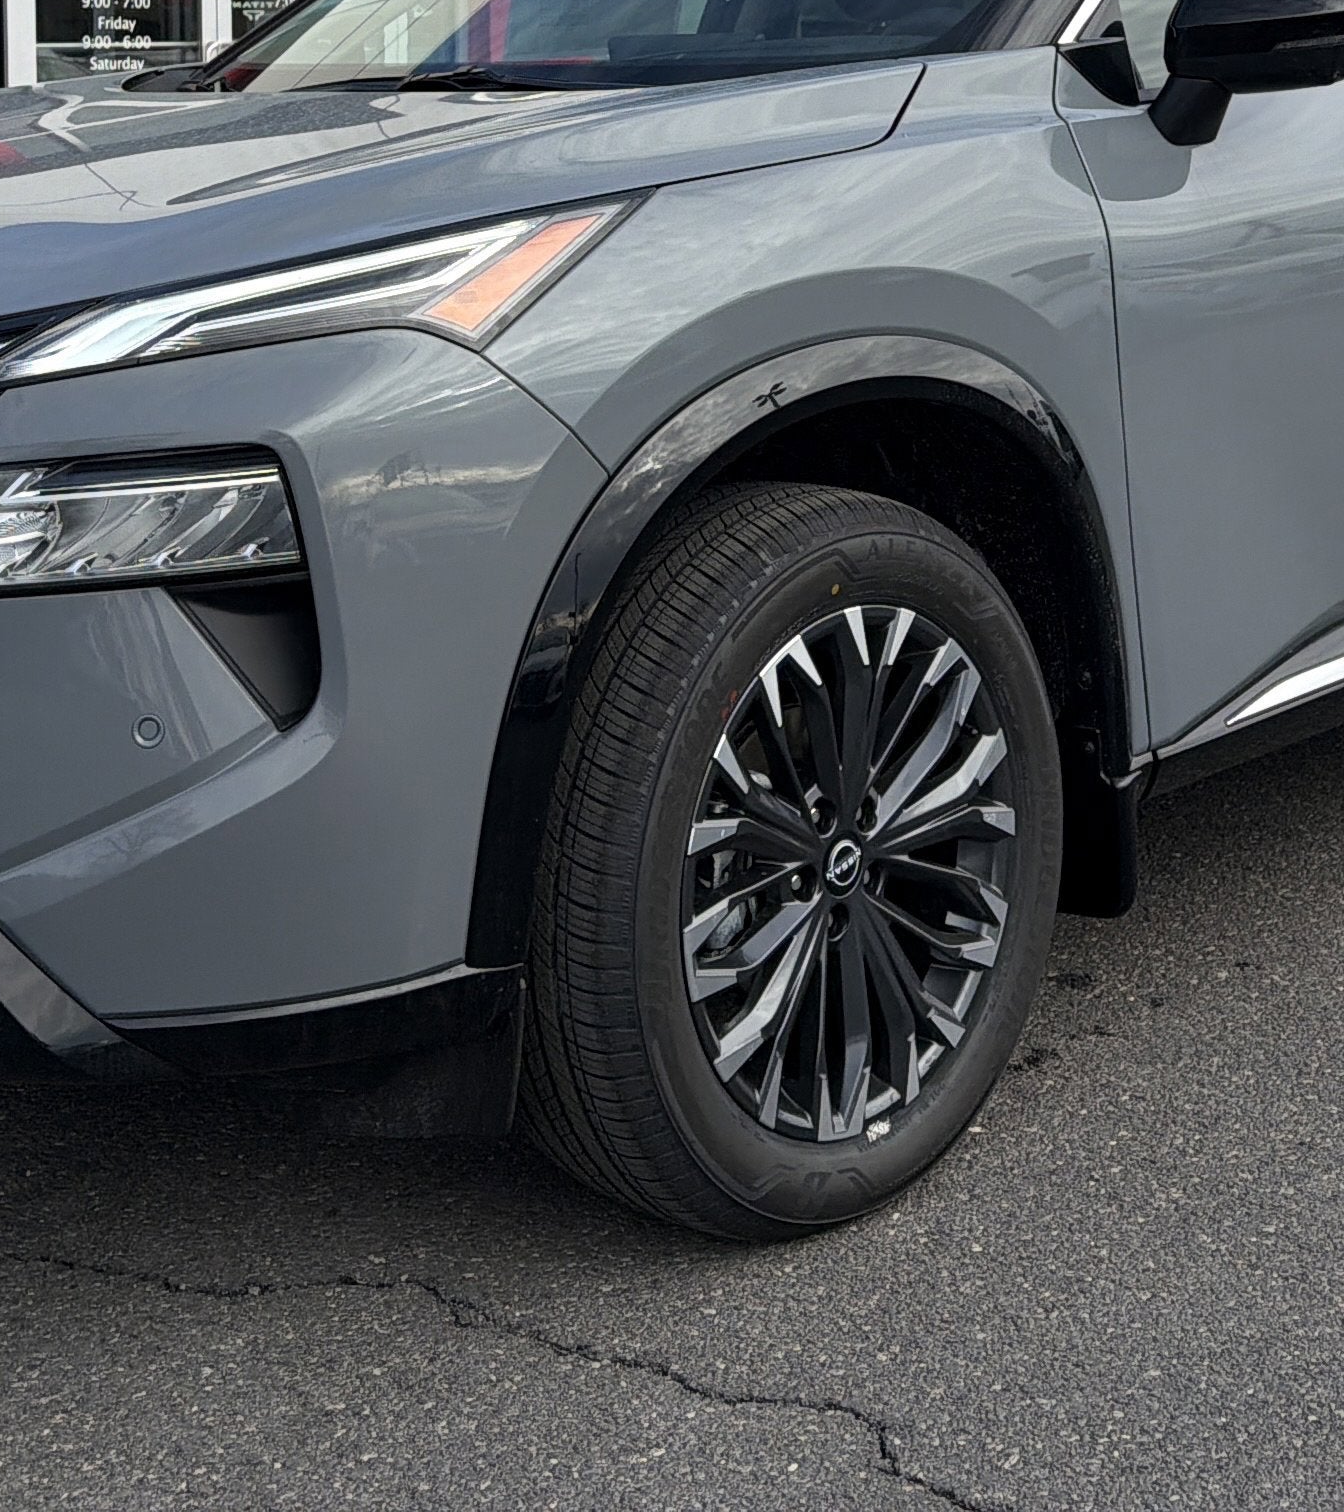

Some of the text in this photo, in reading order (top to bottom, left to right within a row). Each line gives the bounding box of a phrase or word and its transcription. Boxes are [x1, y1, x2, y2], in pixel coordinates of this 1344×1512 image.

[98, 16, 137, 33] Friday
[82, 35, 112, 49] 9:00
[123, 36, 152, 49] 6:00
[89, 56, 145, 71] Saturday
[826, 847, 862, 881] NISSAN
